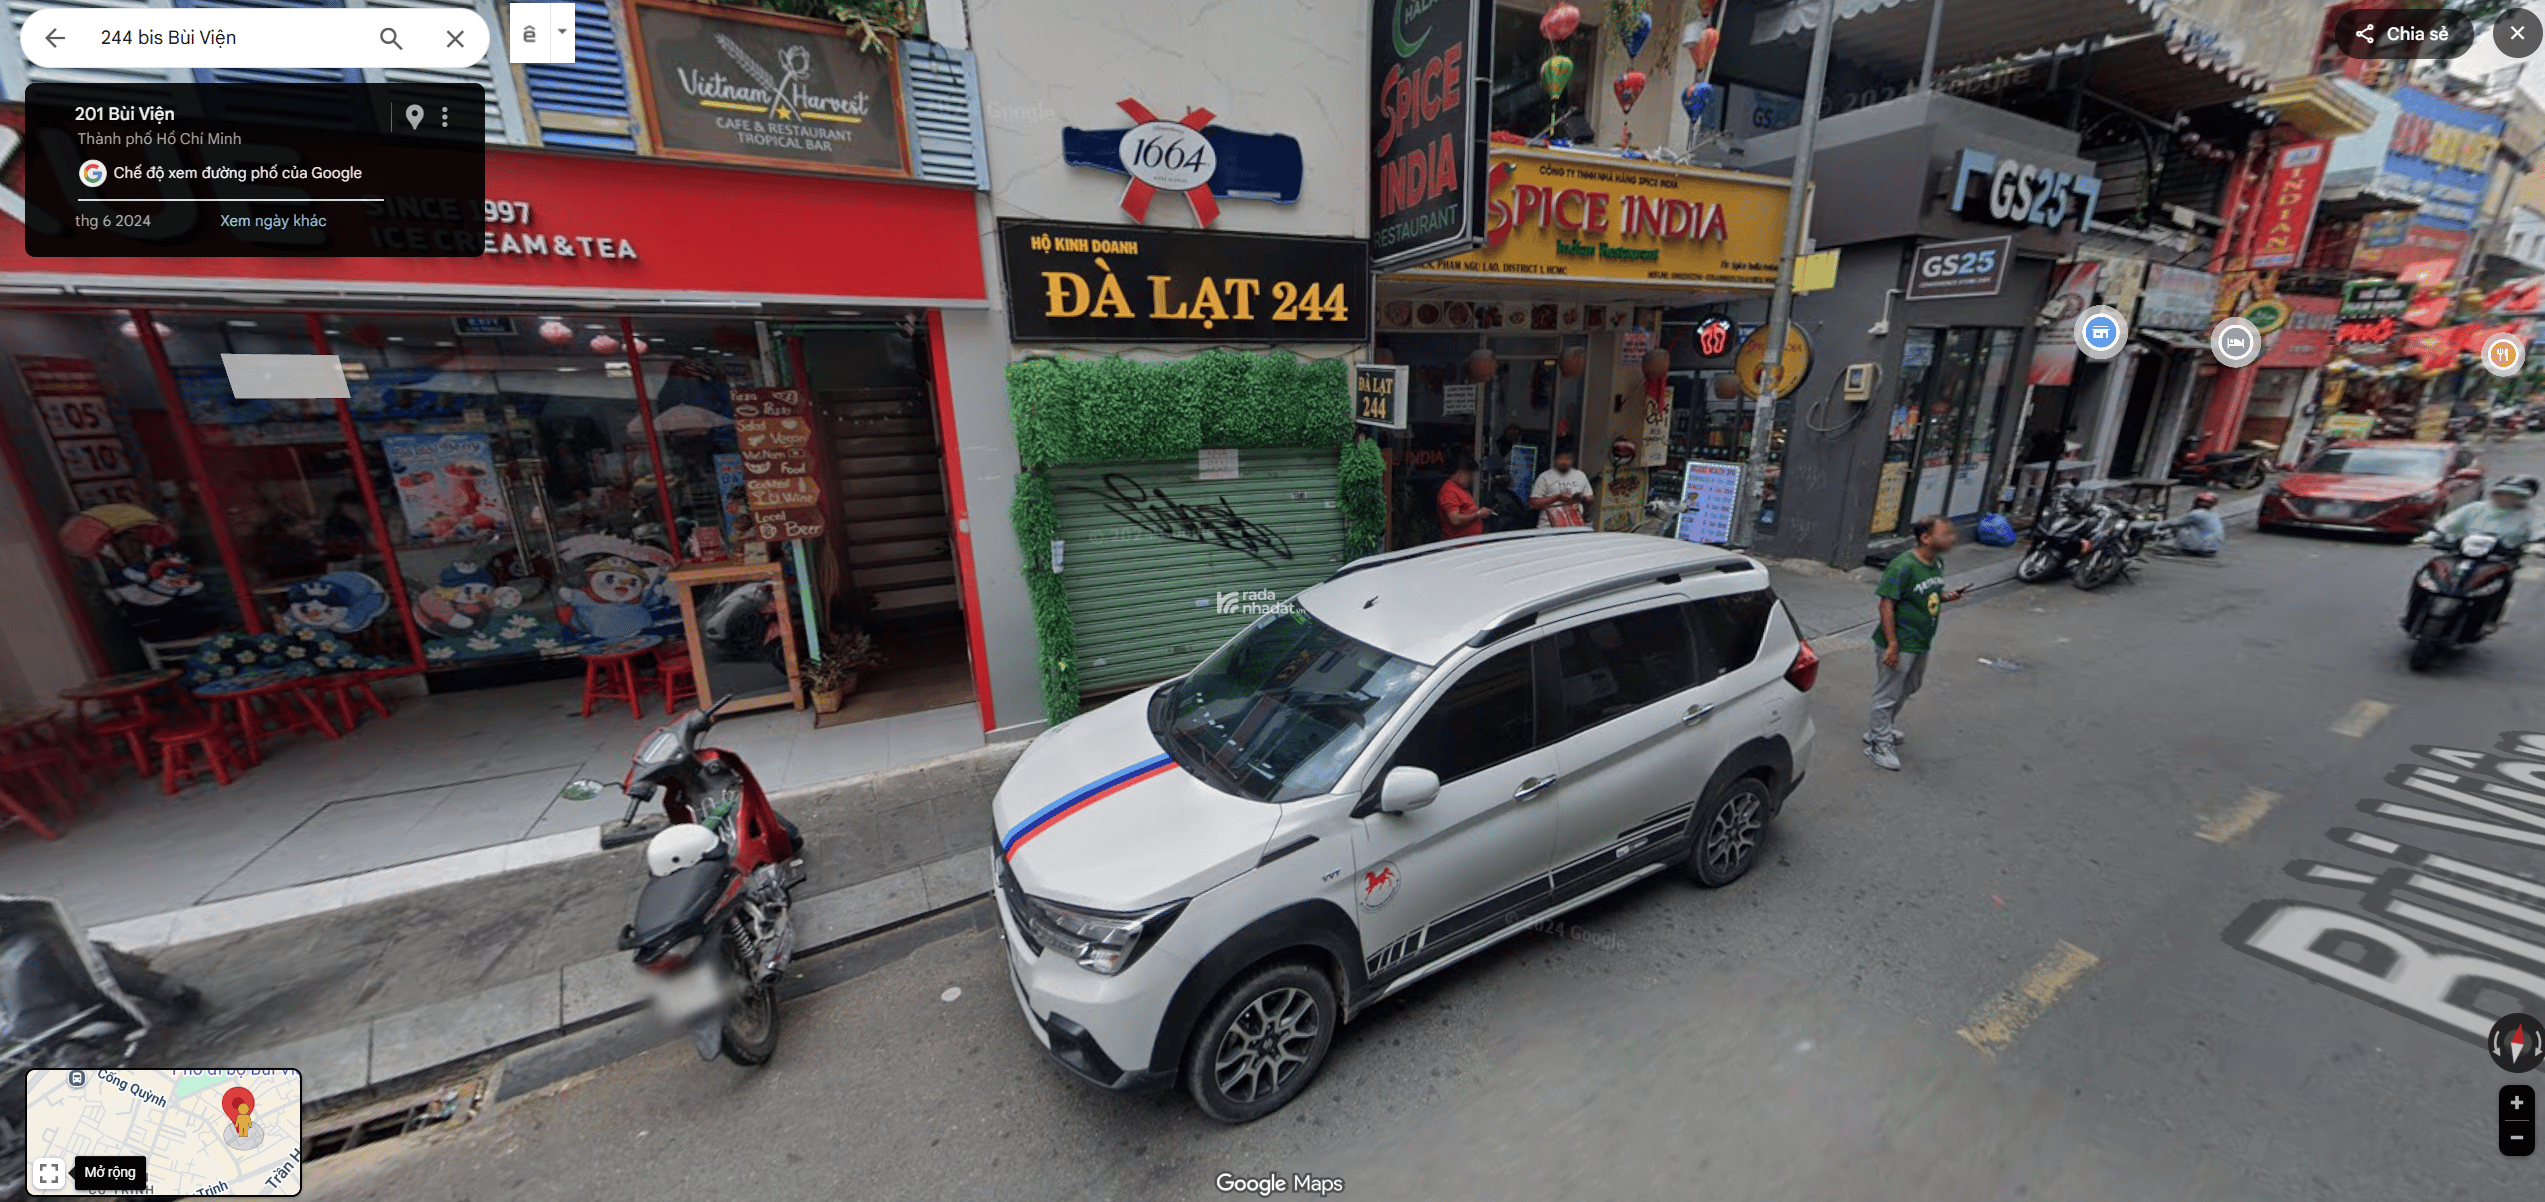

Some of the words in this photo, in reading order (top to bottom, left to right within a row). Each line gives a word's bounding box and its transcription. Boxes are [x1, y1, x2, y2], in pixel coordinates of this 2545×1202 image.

[677, 66, 773, 104] Vietnam
[792, 81, 869, 116] Harvest
[1377, 41, 1463, 158] SPICE
[716, 117, 753, 133] CAFE
[755, 121, 766, 133] &
[768, 122, 853, 142] RESTAURANT
[1753, 107, 1773, 128] GS
[738, 131, 803, 149] TROPICAL
[806, 139, 833, 152] BAR
[1133, 135, 1207, 173] 1664
[1380, 133, 1458, 219] INDIA
[1539, 162, 1565, 177] CÔNG
[1989, 159, 2074, 227] GS25
[472, 198, 532, 226] 1997
[1620, 193, 1728, 241] INDIA
[2266, 167, 2306, 249] INDIAN
[1374, 204, 1459, 249] RESTAURANT
[369, 226, 429, 251] ICE
[433, 228, 550, 257] CREAM
[553, 234, 576, 258] &
[576, 235, 638, 260] TEA
[1030, 233, 1051, 254] HỘ
[1055, 237, 1089, 253] KINH
[1091, 239, 1139, 255] DOANH
[1556, 239, 1597, 257] Indian
[1503, 263, 1538, 274] DISTRICT
[1922, 249, 1996, 278] GS25
[1041, 257, 1136, 319] ĐÀ
[1147, 274, 1260, 330] LẠT
[1272, 281, 1349, 322] 244
[729, 388, 758, 401] Pizza
[1357, 374, 1372, 393] ĐÀ
[1373, 376, 1394, 395] LẠT
[63, 402, 101, 429] 05
[762, 401, 793, 416] Pasta
[1361, 395, 1387, 420] 244
[736, 419, 767, 432] Salad
[83, 444, 117, 470] 10
[780, 461, 807, 474] Food
[1404, 448, 1446, 467] INDIA
[782, 492, 815, 504] Wine
[755, 509, 787, 524] Local
[783, 520, 824, 536] Beer
